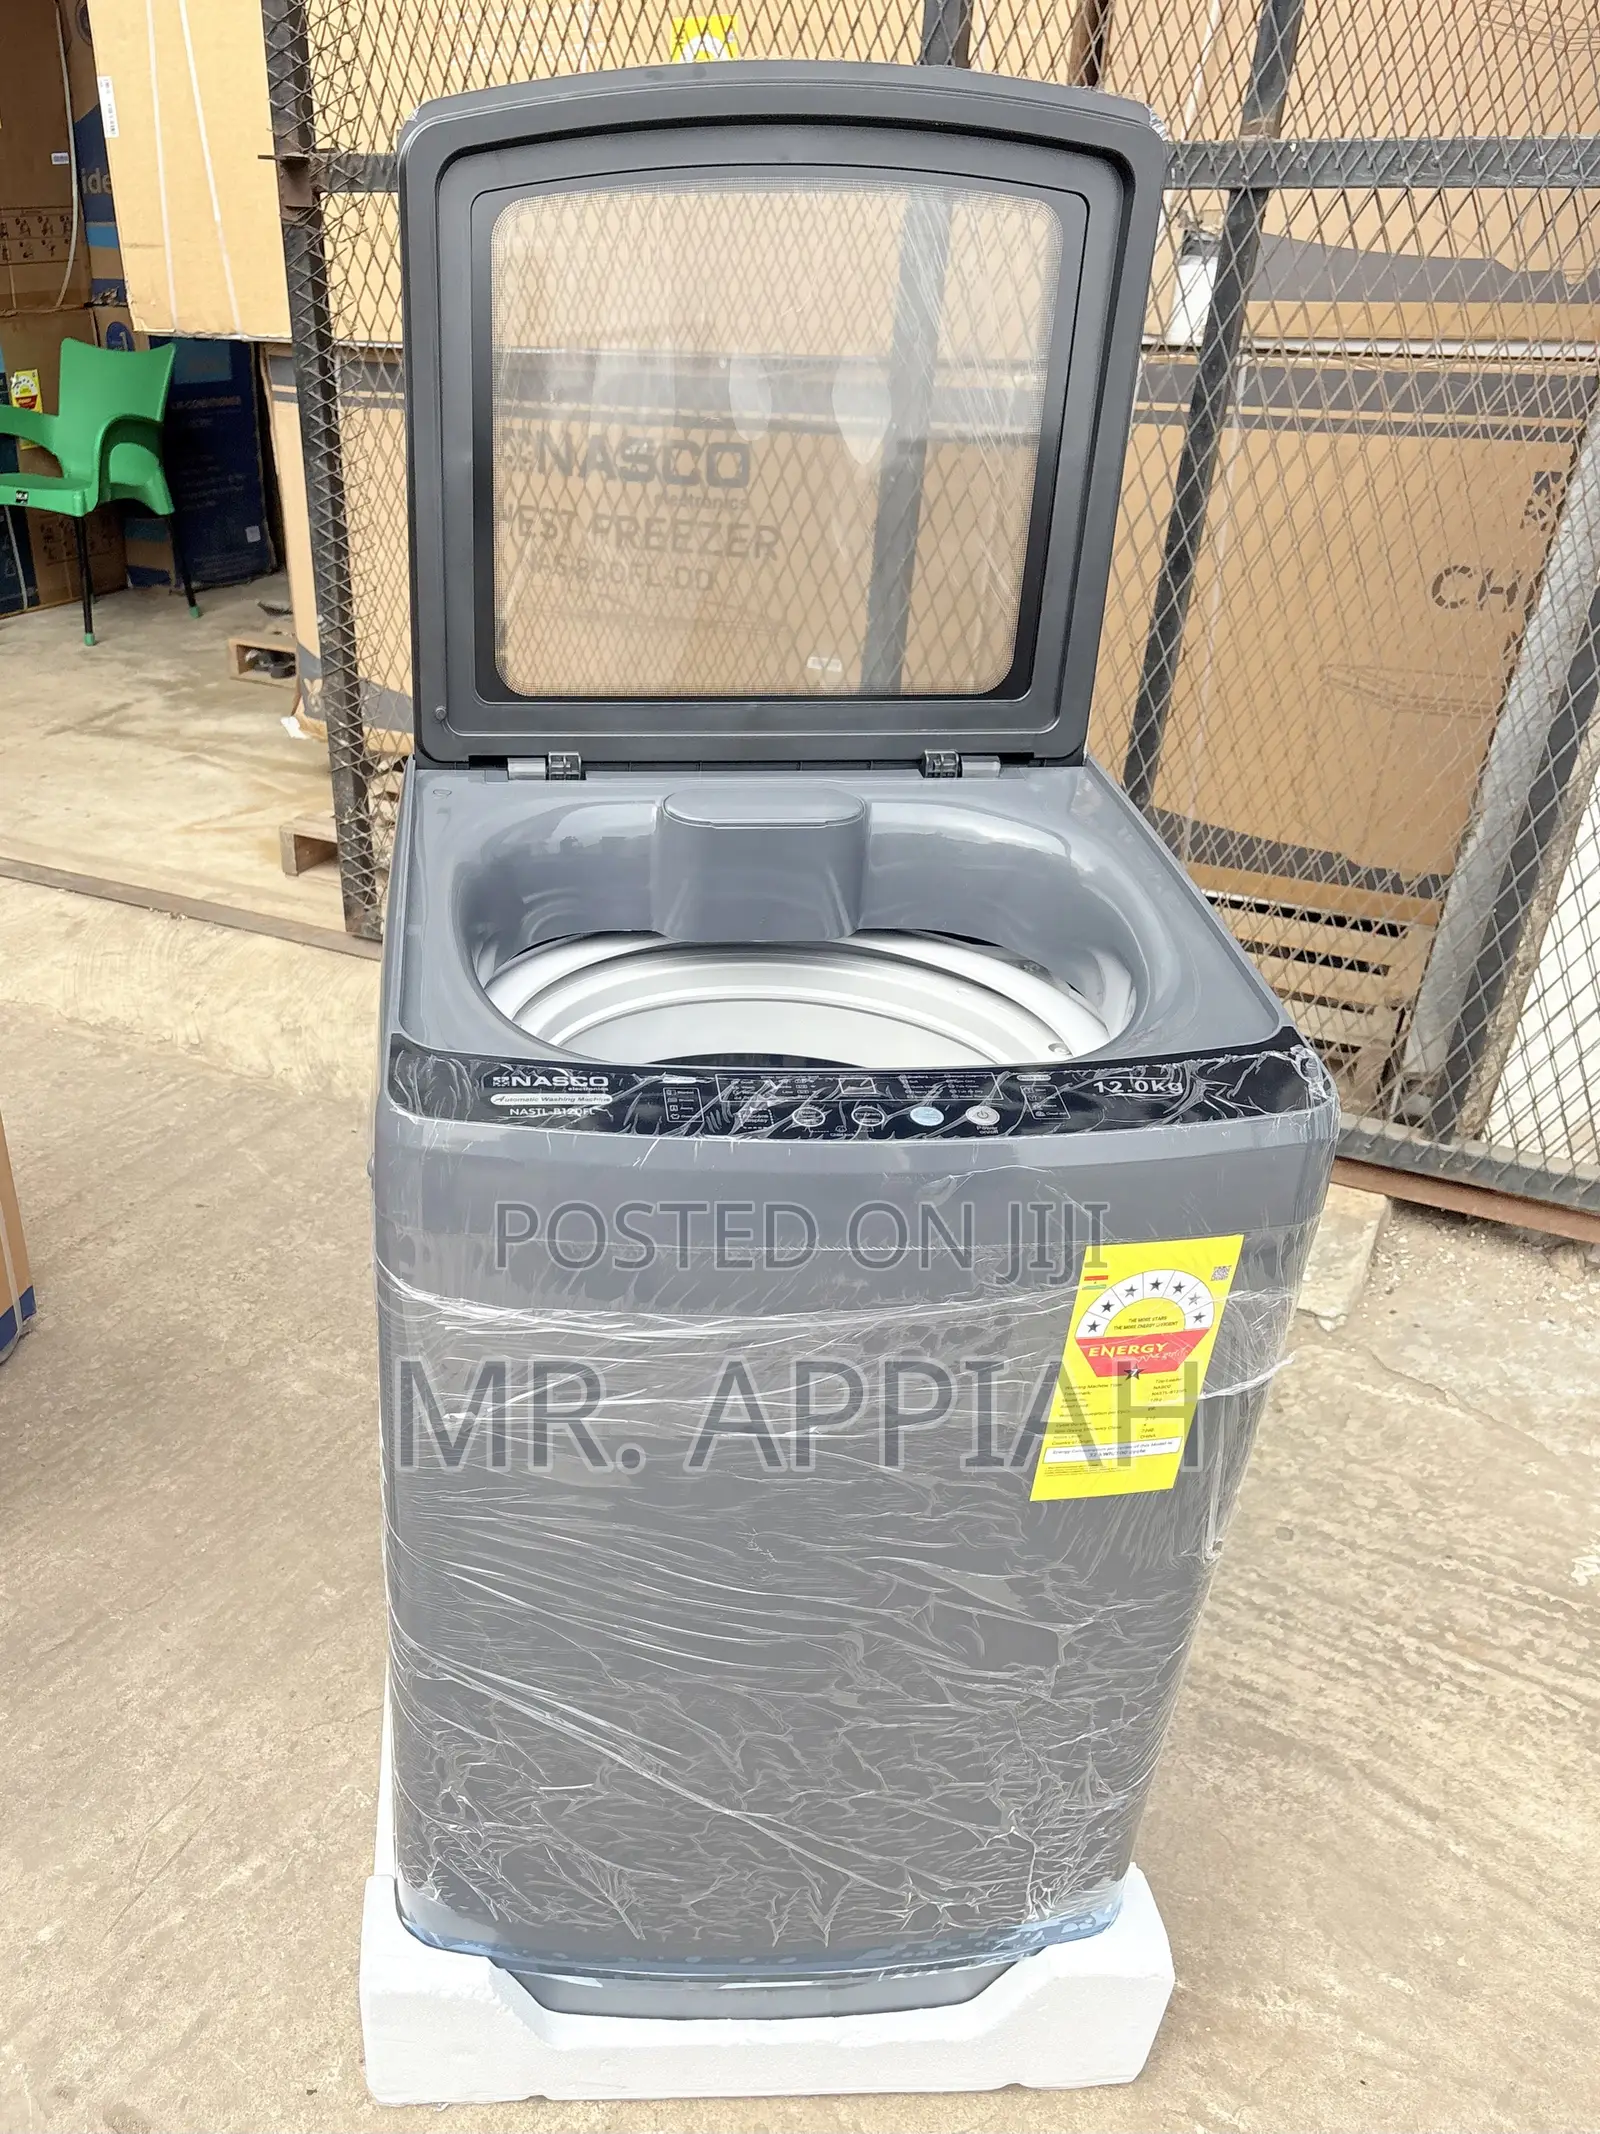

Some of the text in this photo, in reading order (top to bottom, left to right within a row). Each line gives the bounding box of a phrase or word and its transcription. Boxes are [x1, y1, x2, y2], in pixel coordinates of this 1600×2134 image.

[537, 431, 750, 488] NASCO
[591, 513, 781, 562] FREEZER
[511, 1076, 609, 1087] NASCO
[1094, 1080, 1183, 1094] 12.0kg
[1088, 1342, 1169, 1359] ENERGY
